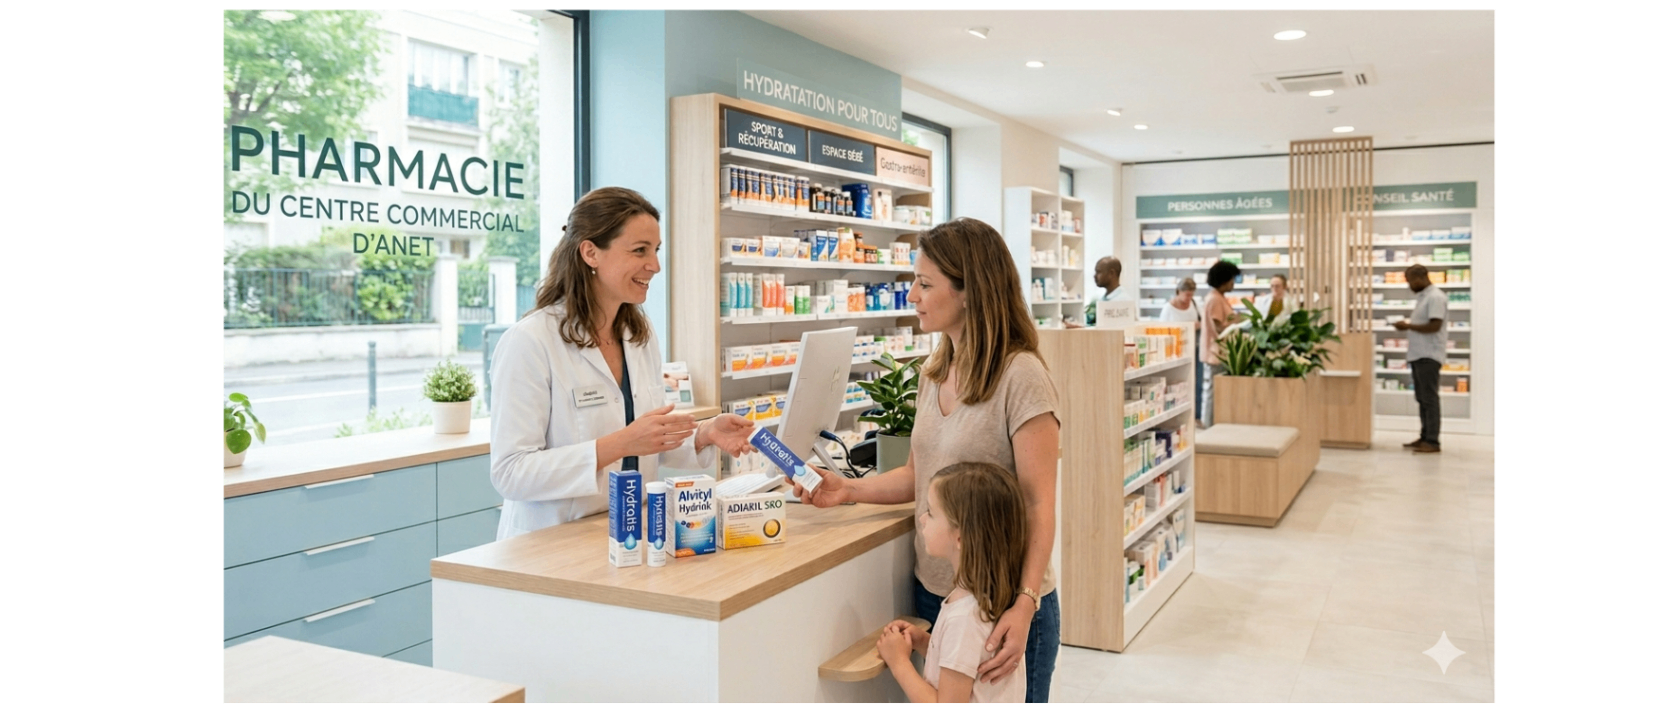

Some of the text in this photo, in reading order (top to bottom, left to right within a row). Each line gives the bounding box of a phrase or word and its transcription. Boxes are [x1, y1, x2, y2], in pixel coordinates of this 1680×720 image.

[743, 70, 898, 132] HYDRATATION POUR TOUS
[738, 130, 796, 155] RÉCUPÉRATION
[778, 127, 784, 139] &
[822, 144, 846, 159] ESPACE
[231, 125, 525, 200] PHARMACIE
[1411, 188, 1455, 203] SANTÉ
[232, 190, 525, 233] DU CENTRE COMMERCIAL
[1167, 200, 1234, 212] PERSONNES
[353, 232, 435, 257] D'ANET
[764, 499, 783, 510] SRO
